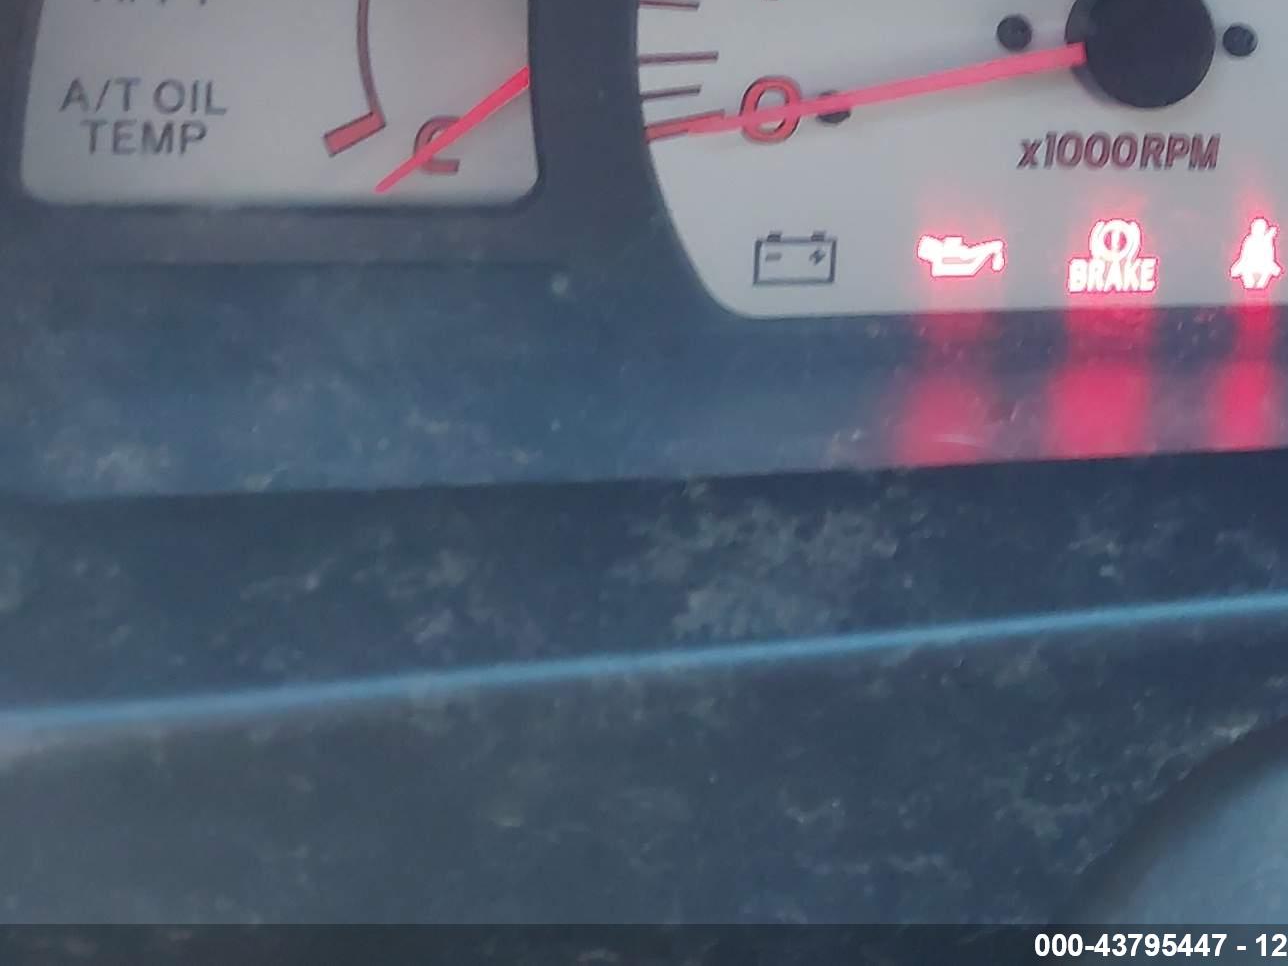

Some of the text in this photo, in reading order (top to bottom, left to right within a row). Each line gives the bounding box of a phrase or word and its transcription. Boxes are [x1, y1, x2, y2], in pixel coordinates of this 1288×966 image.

[58, 78, 228, 116] A/T OIL
[739, 74, 801, 144] 0
[80, 119, 209, 158] TEMP
[1066, 257, 1160, 294] BRAKE
